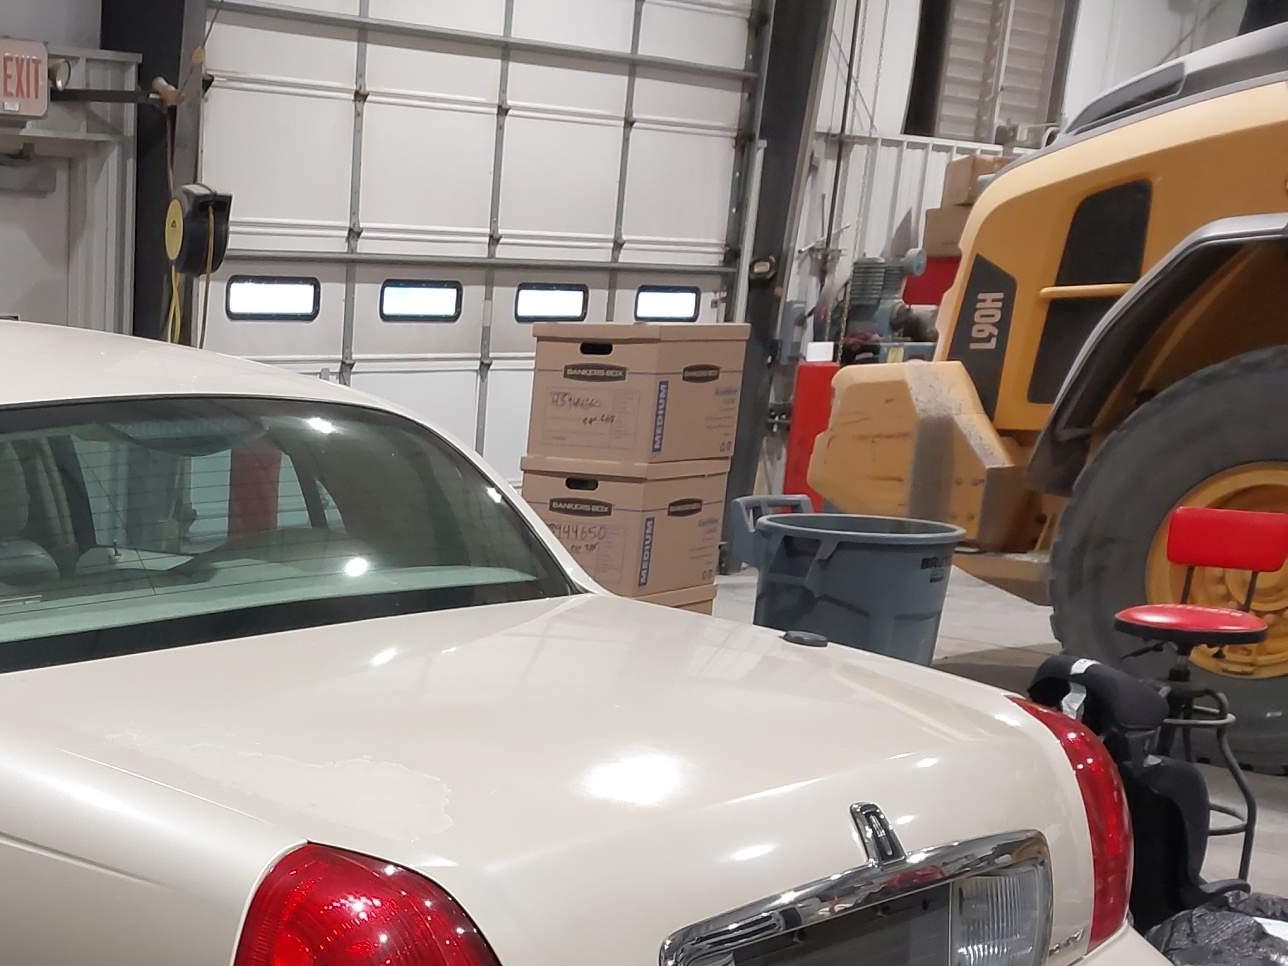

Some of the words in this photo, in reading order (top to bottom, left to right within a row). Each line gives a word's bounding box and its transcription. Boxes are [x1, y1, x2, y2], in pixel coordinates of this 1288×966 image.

[2, 55, 41, 99] EXIT
[969, 292, 1005, 350] L90H
[654, 384, 668, 450] MEDIUM
[552, 501, 590, 512] BANKERS
[591, 503, 609, 513] BOX
[639, 518, 654, 584] MEDIUM
